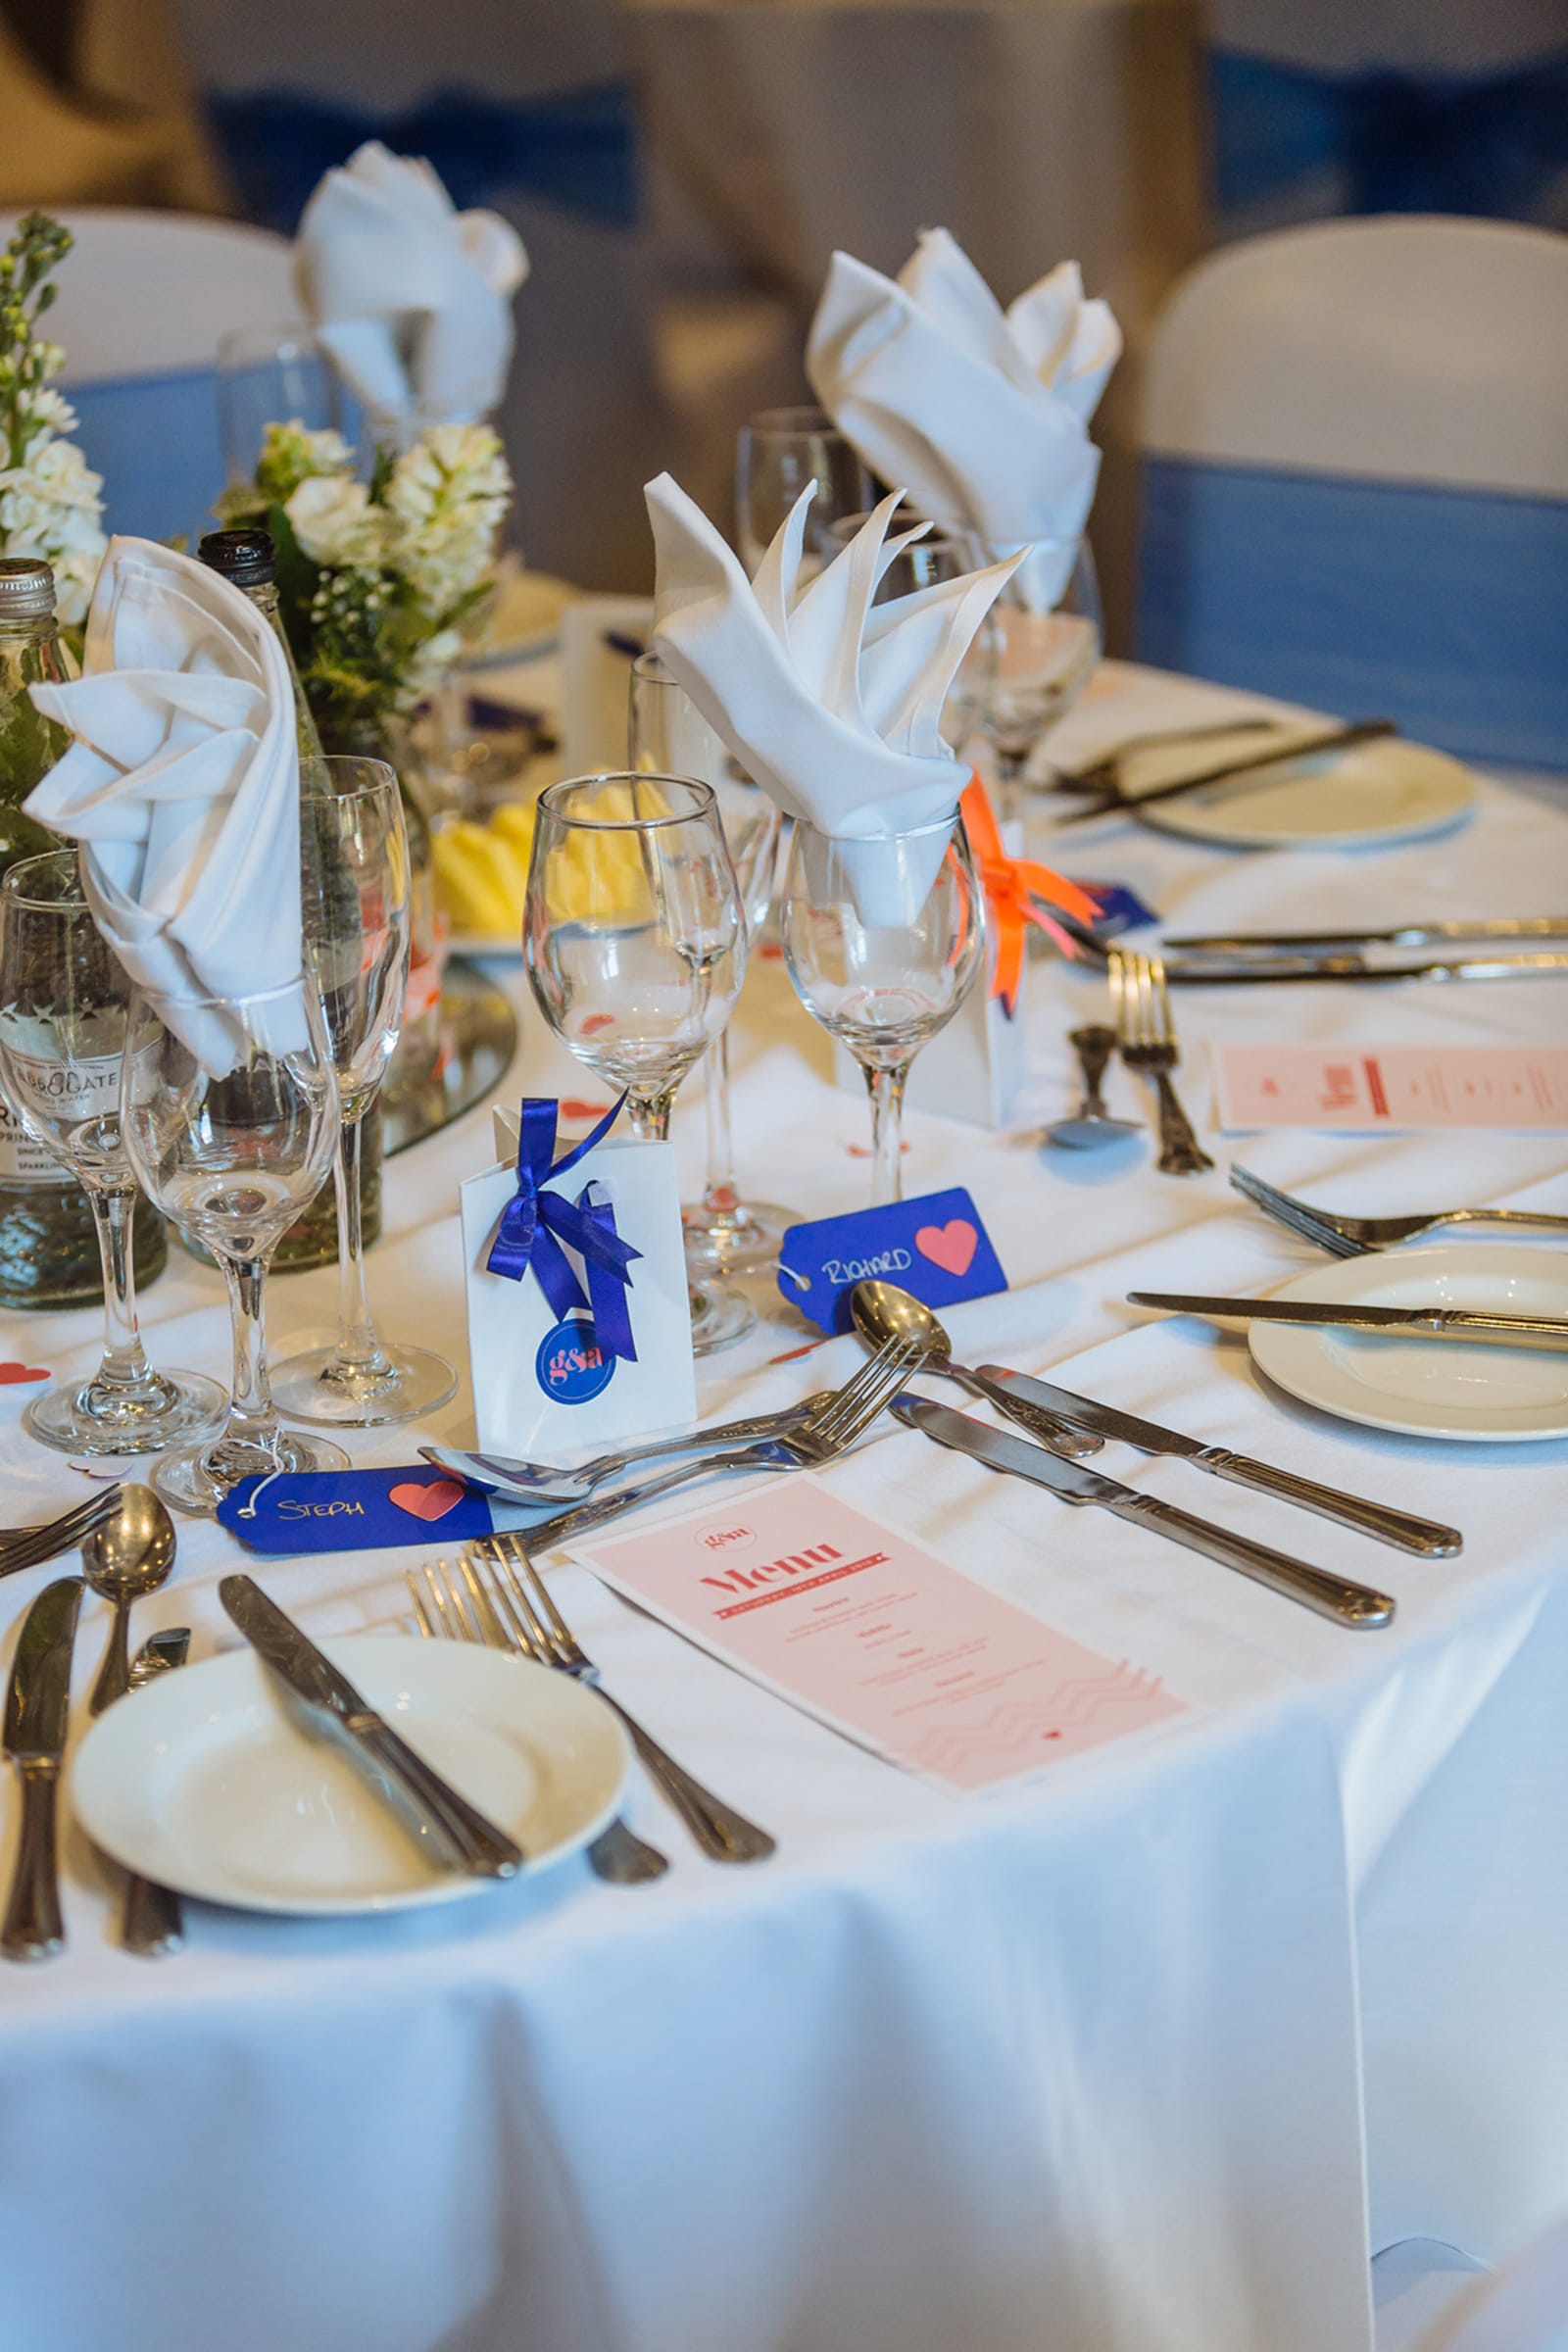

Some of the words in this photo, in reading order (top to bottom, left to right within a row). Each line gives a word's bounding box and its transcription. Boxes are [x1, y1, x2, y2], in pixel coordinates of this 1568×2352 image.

[821, 1248, 912, 1285] RICHARD
[276, 1499, 366, 1521] STEPH
[699, 1544, 844, 1594] Menu
